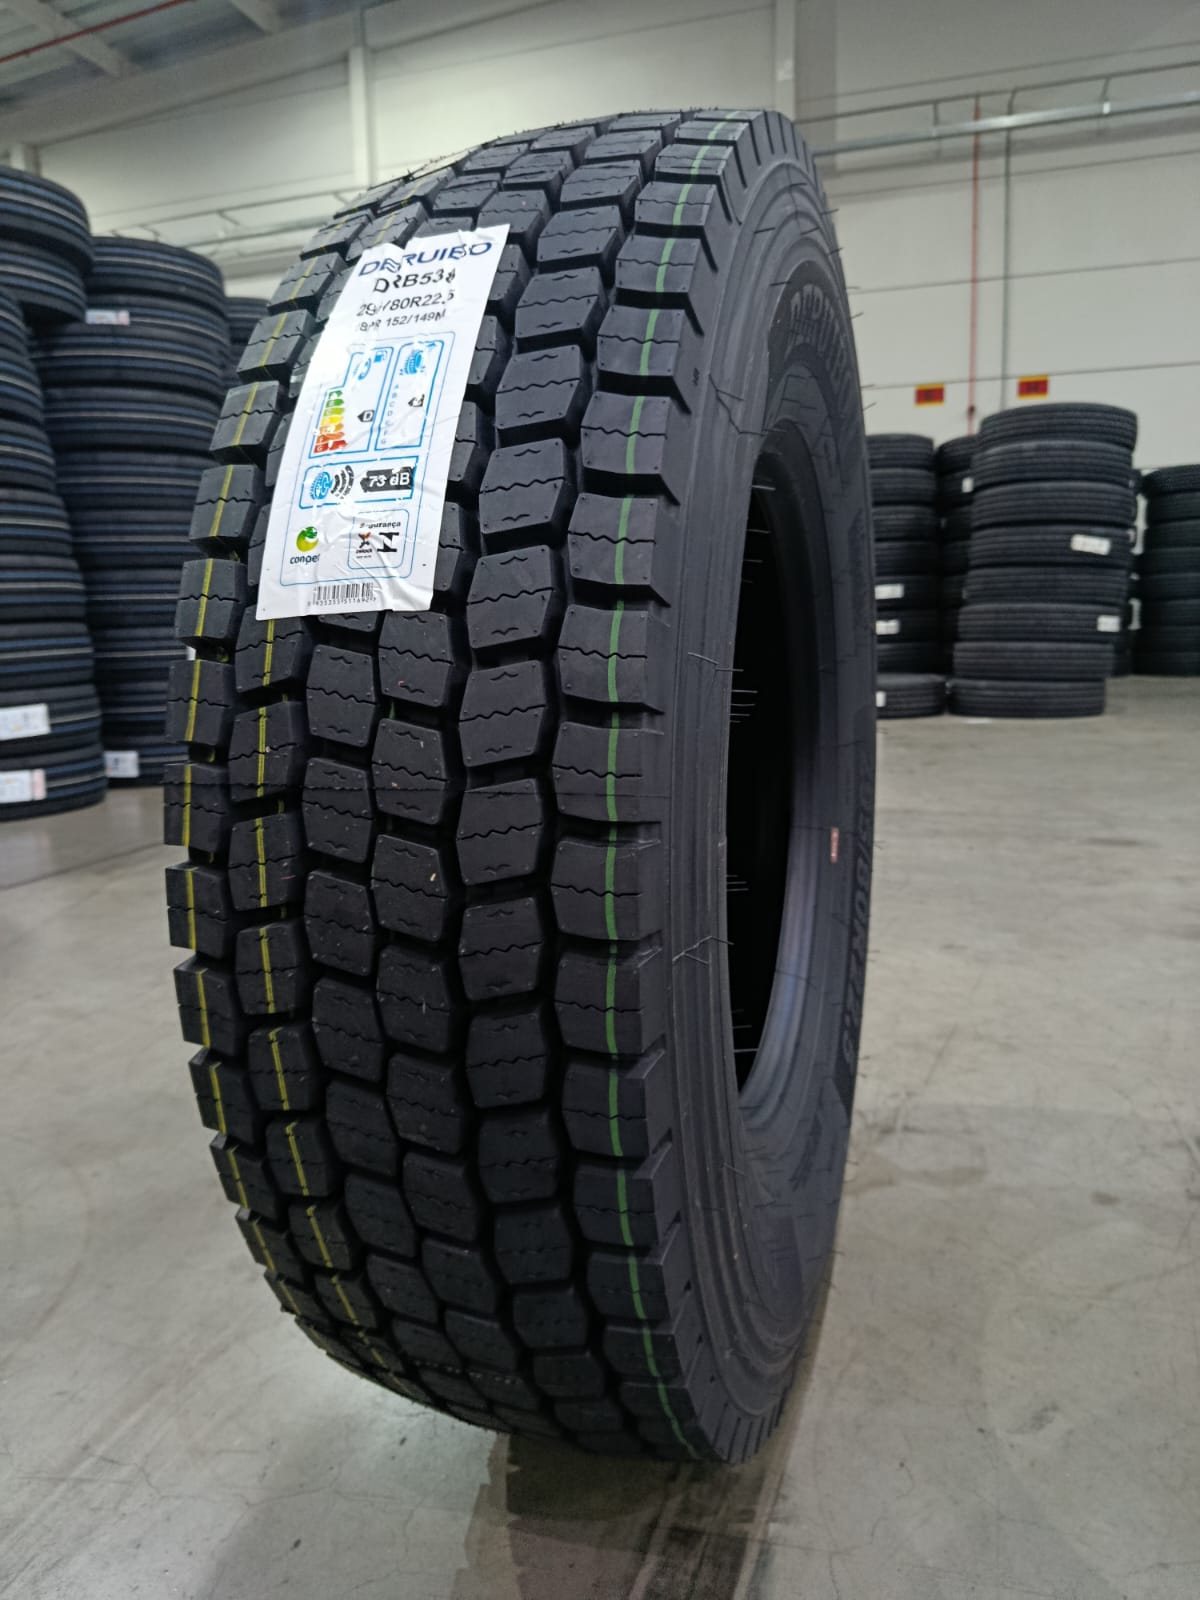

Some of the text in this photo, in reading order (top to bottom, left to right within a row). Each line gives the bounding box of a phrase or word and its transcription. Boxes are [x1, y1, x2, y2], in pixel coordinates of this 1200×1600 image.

[356, 289, 456, 317] 29/80R22.5
[363, 411, 374, 421] D
[369, 472, 410, 488] 73 dB
